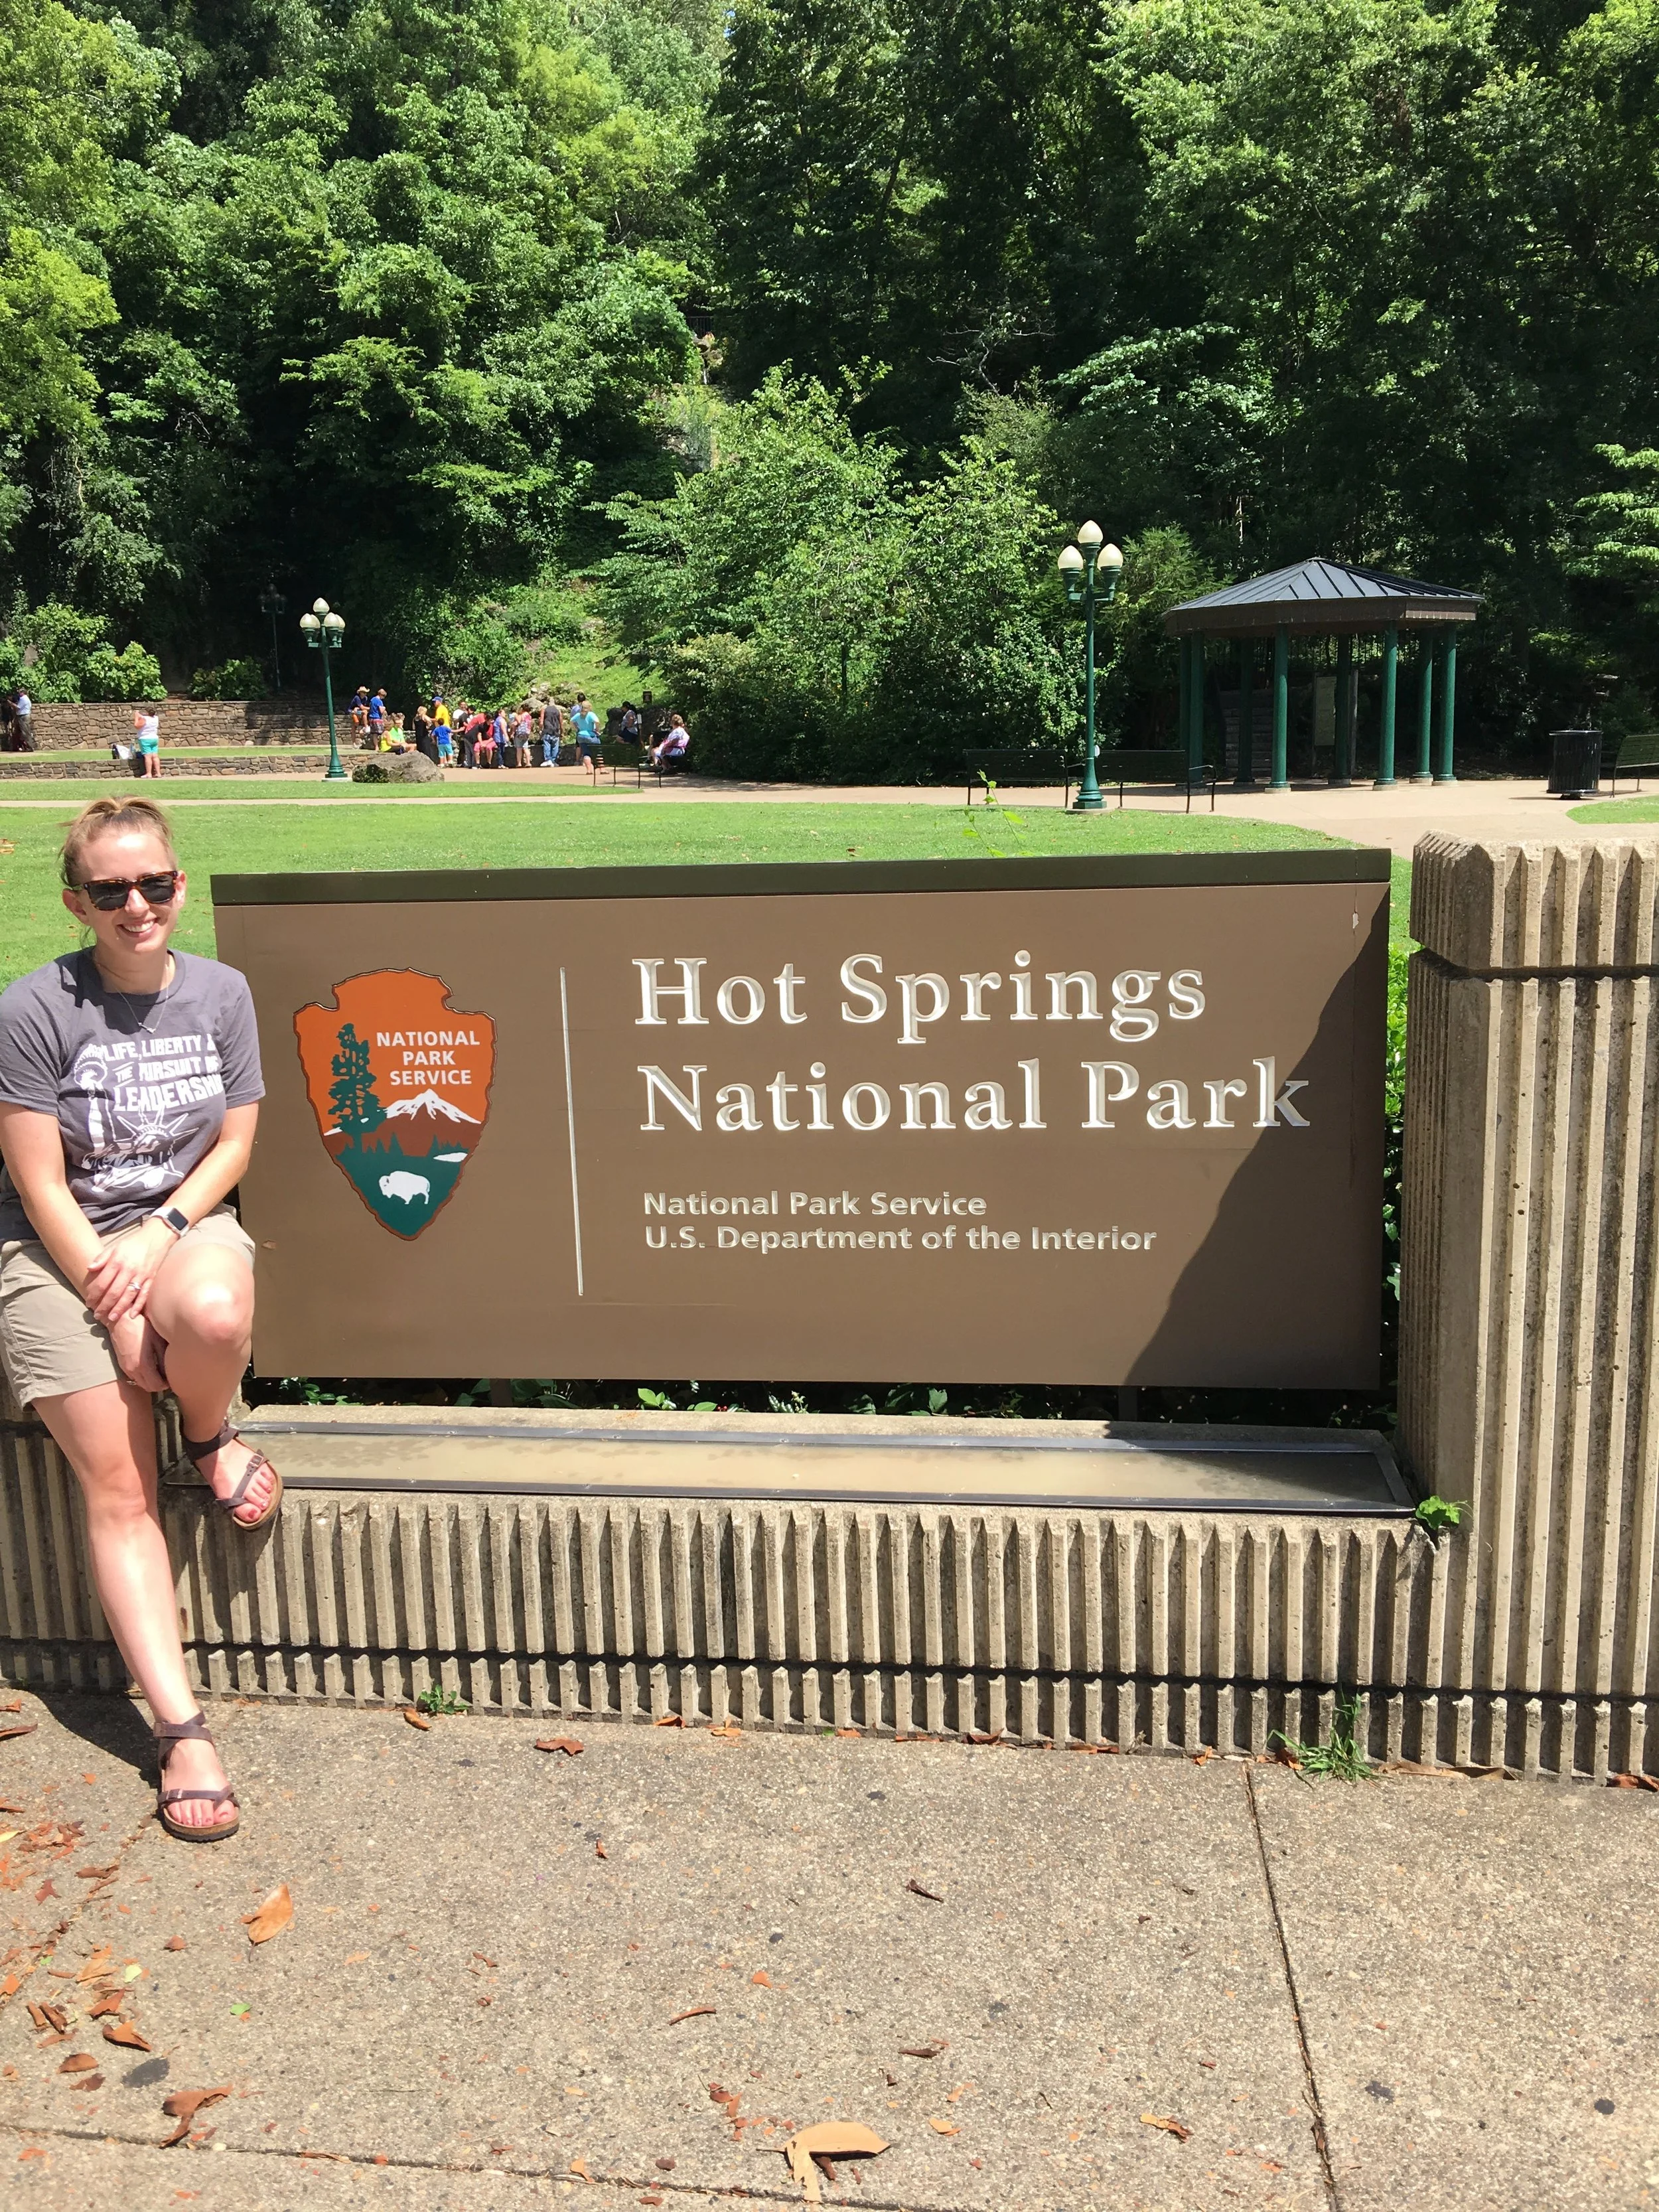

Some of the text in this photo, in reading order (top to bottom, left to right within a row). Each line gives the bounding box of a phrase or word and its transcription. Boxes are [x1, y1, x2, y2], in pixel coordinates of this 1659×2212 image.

[632, 950, 1206, 1045] Hot Springs
[104, 1041, 143, 1062] LIFE,
[141, 1035, 202, 1057] LIBERTY
[376, 1030, 480, 1047] NATIONAL
[115, 1066, 133, 1083] THE
[138, 1057, 202, 1082] PURSUIT
[402, 1050, 457, 1066] PARK
[390, 1069, 472, 1086] SERVICE
[113, 1073, 224, 1112] LEADERSHI
[637, 1056, 1311, 1132] National Park
[644, 1191, 987, 1215] National Park Service
[645, 1224, 1157, 1254] U.S. Department of the Interior
